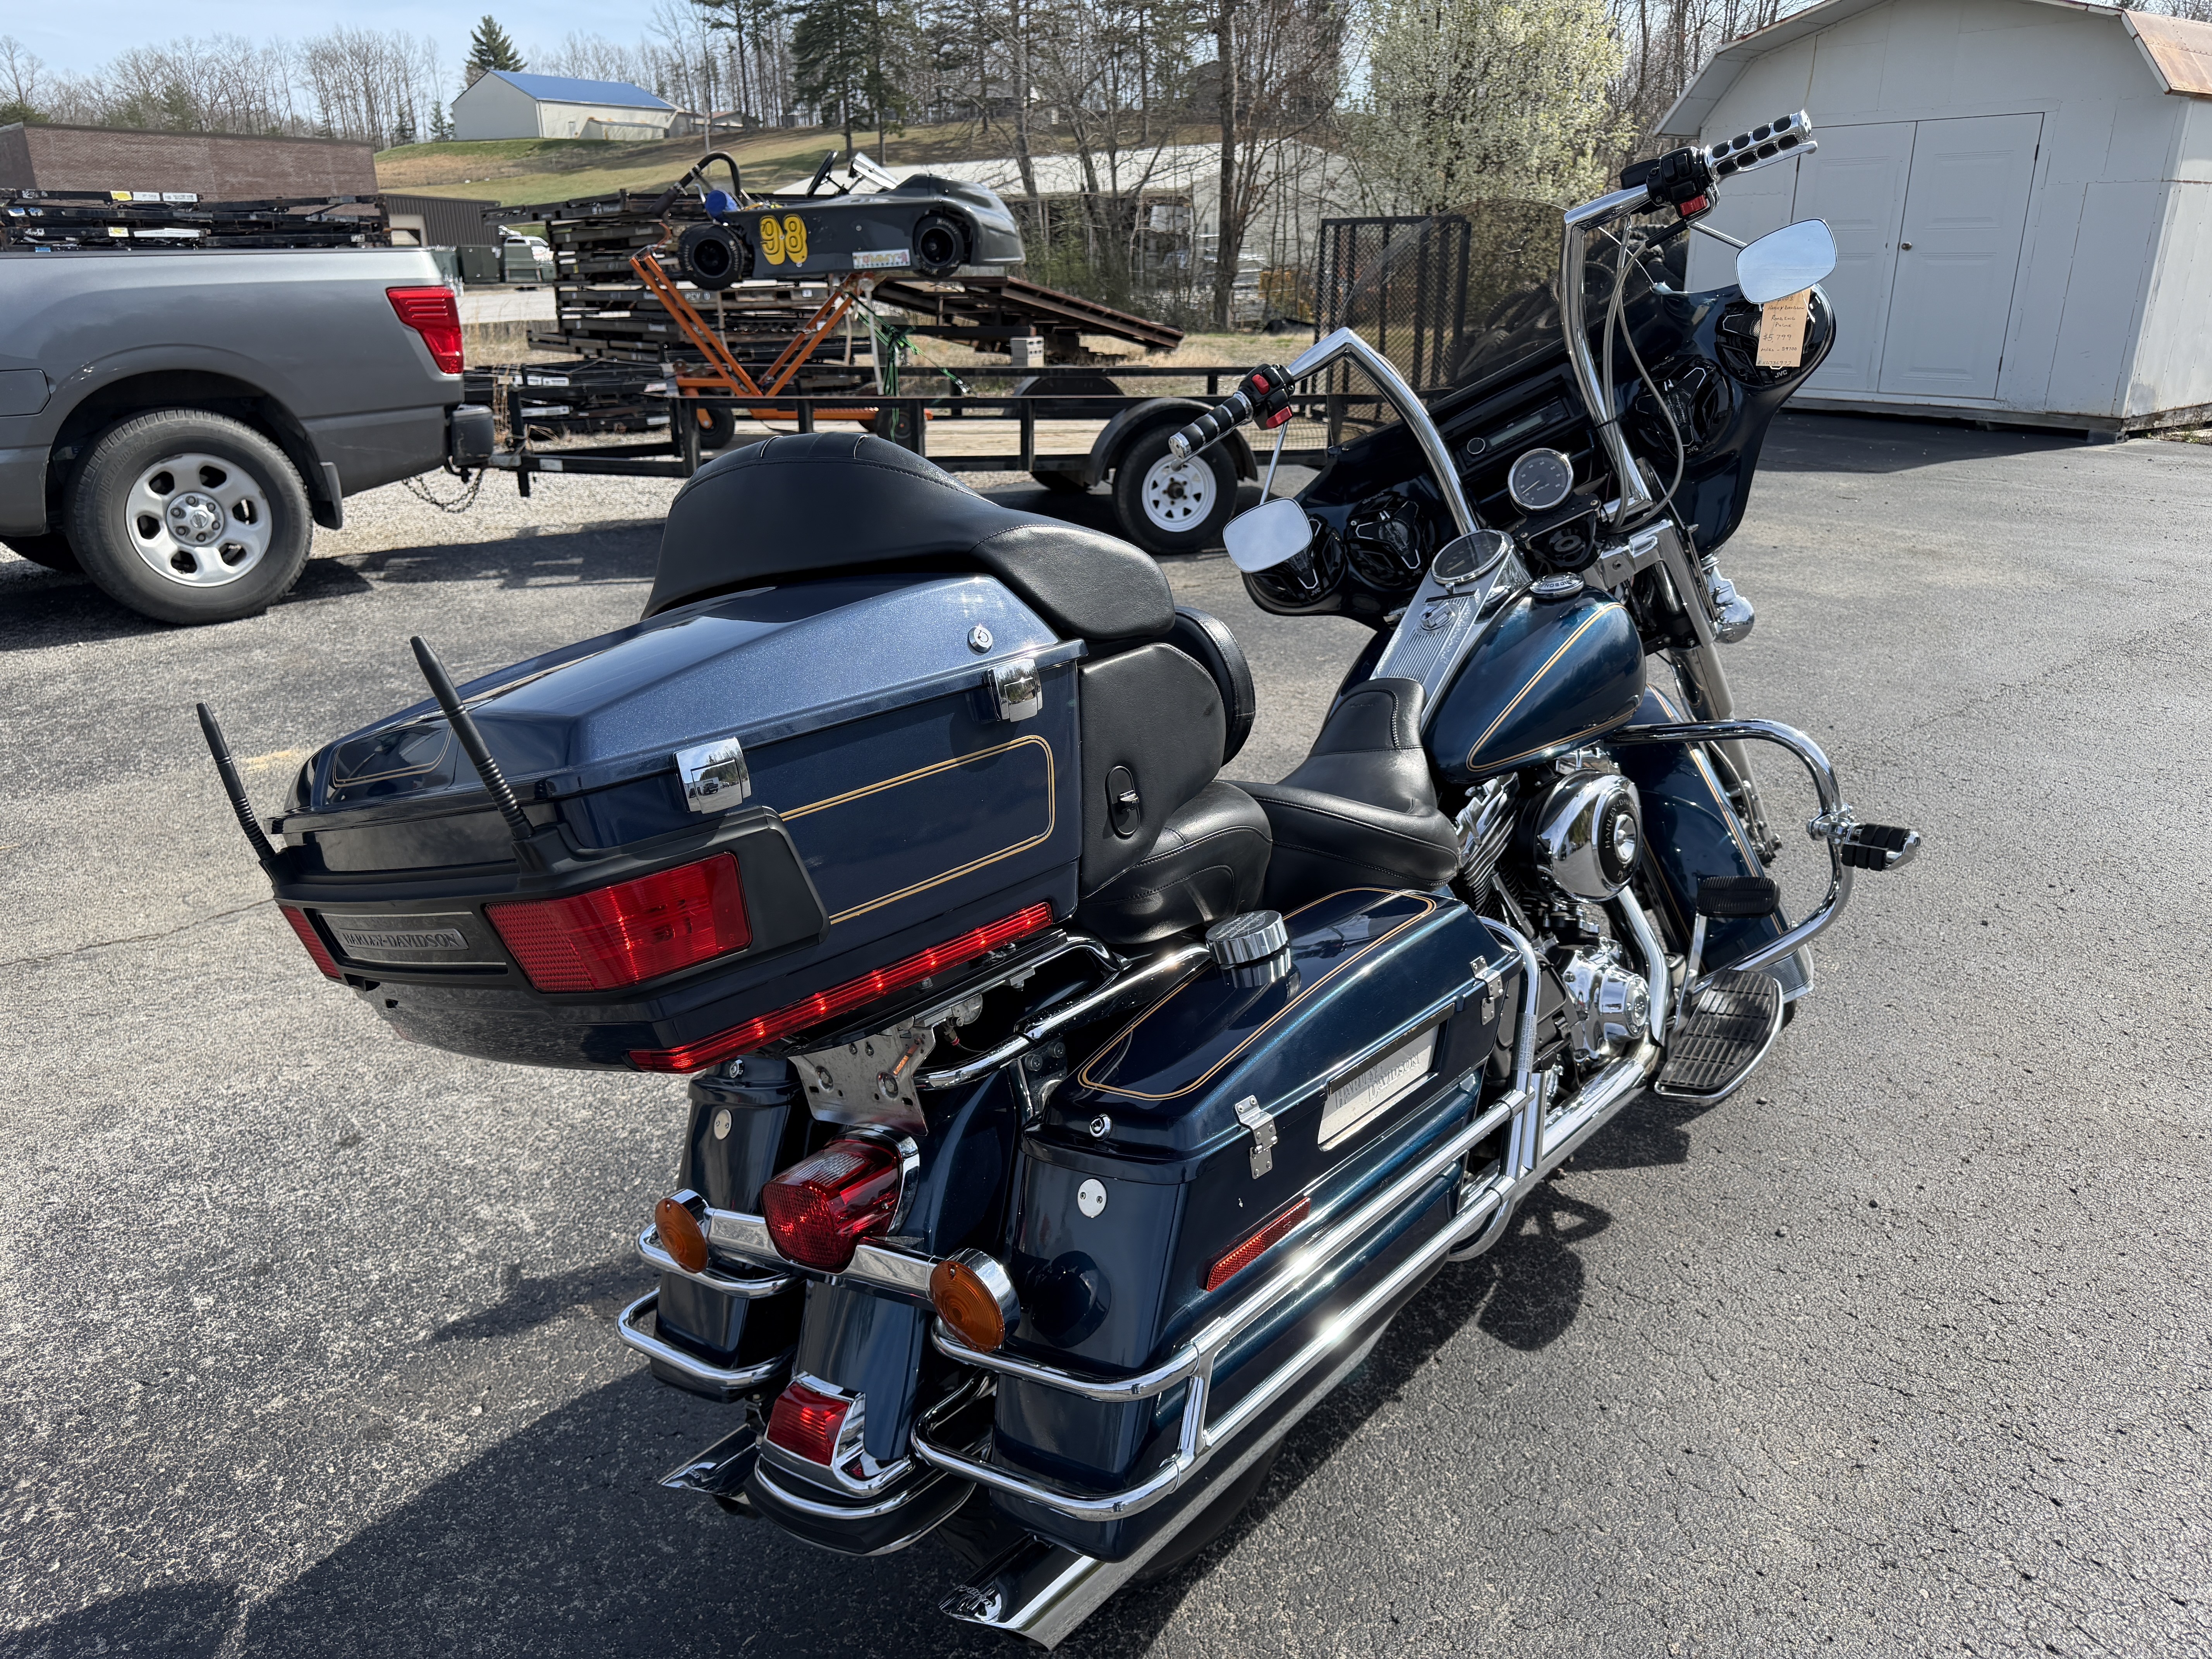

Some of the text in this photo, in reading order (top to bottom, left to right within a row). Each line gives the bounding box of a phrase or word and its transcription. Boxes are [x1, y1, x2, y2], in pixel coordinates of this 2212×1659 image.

[759, 214, 808, 265] 98
[1763, 333, 1791, 343] $5,799
[1775, 369, 1788, 378] JVC
[1687, 445, 1698, 453] JVC
[343, 932, 458, 948] HARLEY-DAVIDSON
[1368, 1051, 1419, 1103] DAVIDSON
